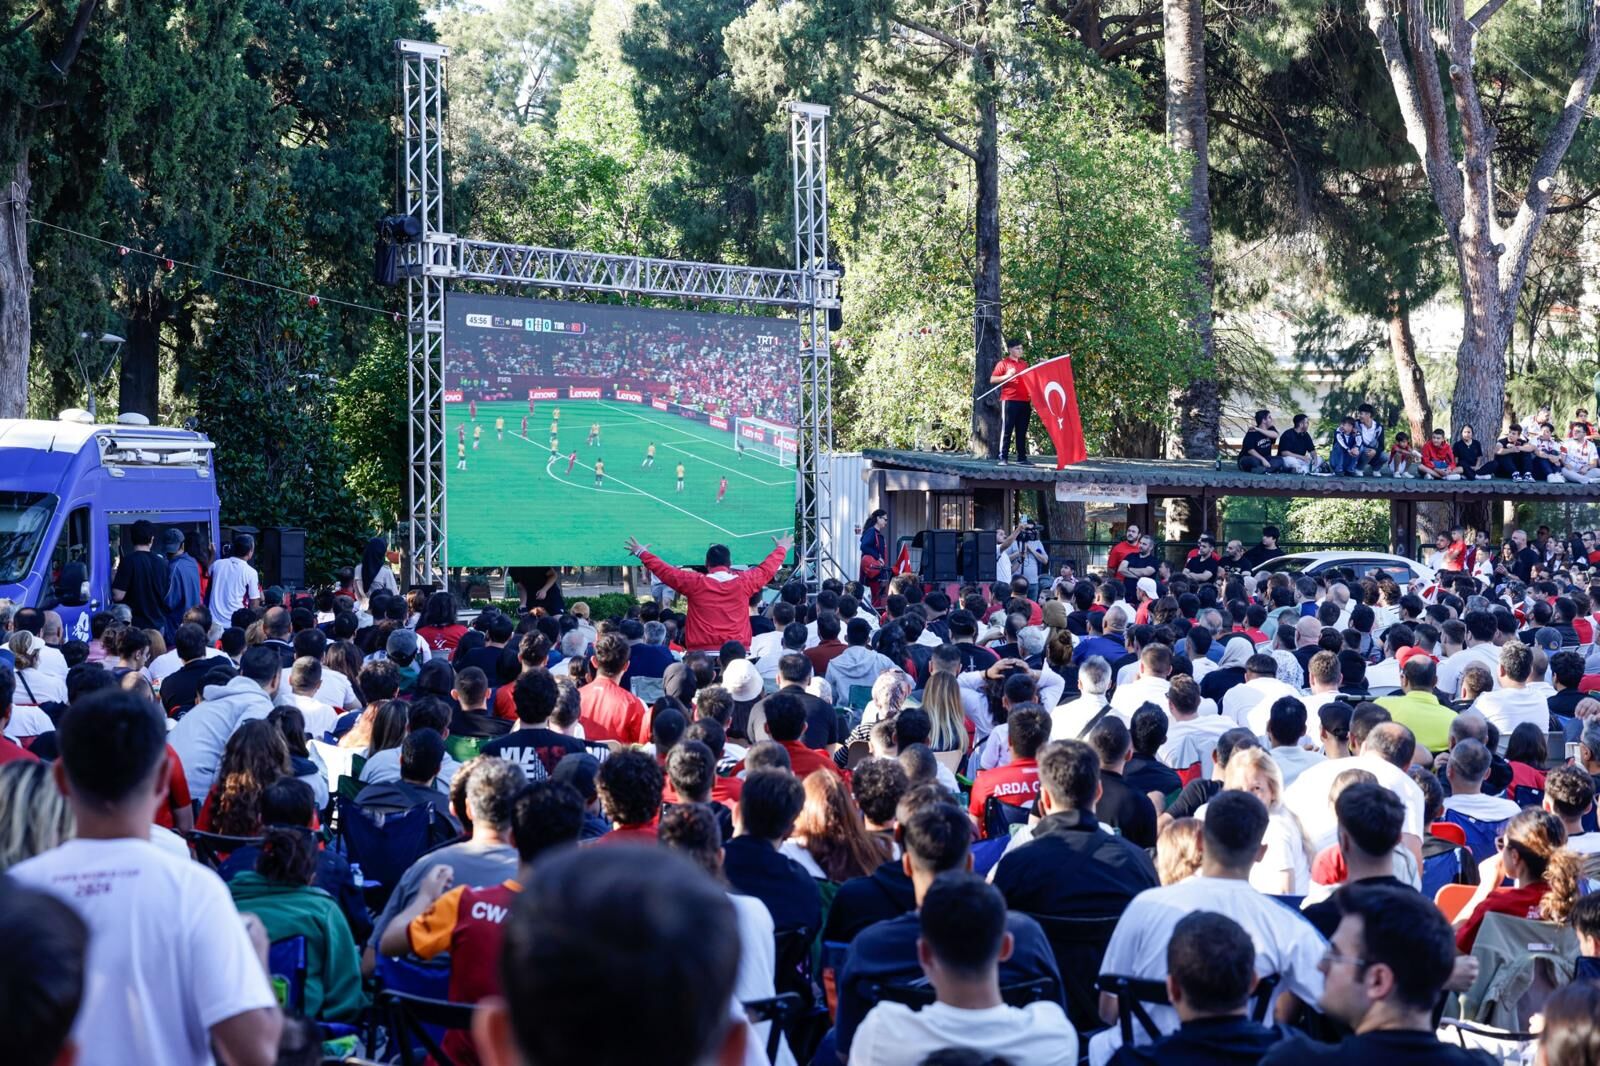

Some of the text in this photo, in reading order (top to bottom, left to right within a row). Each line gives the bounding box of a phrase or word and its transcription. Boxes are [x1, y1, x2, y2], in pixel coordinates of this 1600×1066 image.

[469, 316, 488, 325] 45:56
[756, 335, 774, 345] TRT
[528, 390, 558, 400] Lenovo
[569, 388, 600, 399] Lenovo
[993, 782, 1031, 797] ARDA
